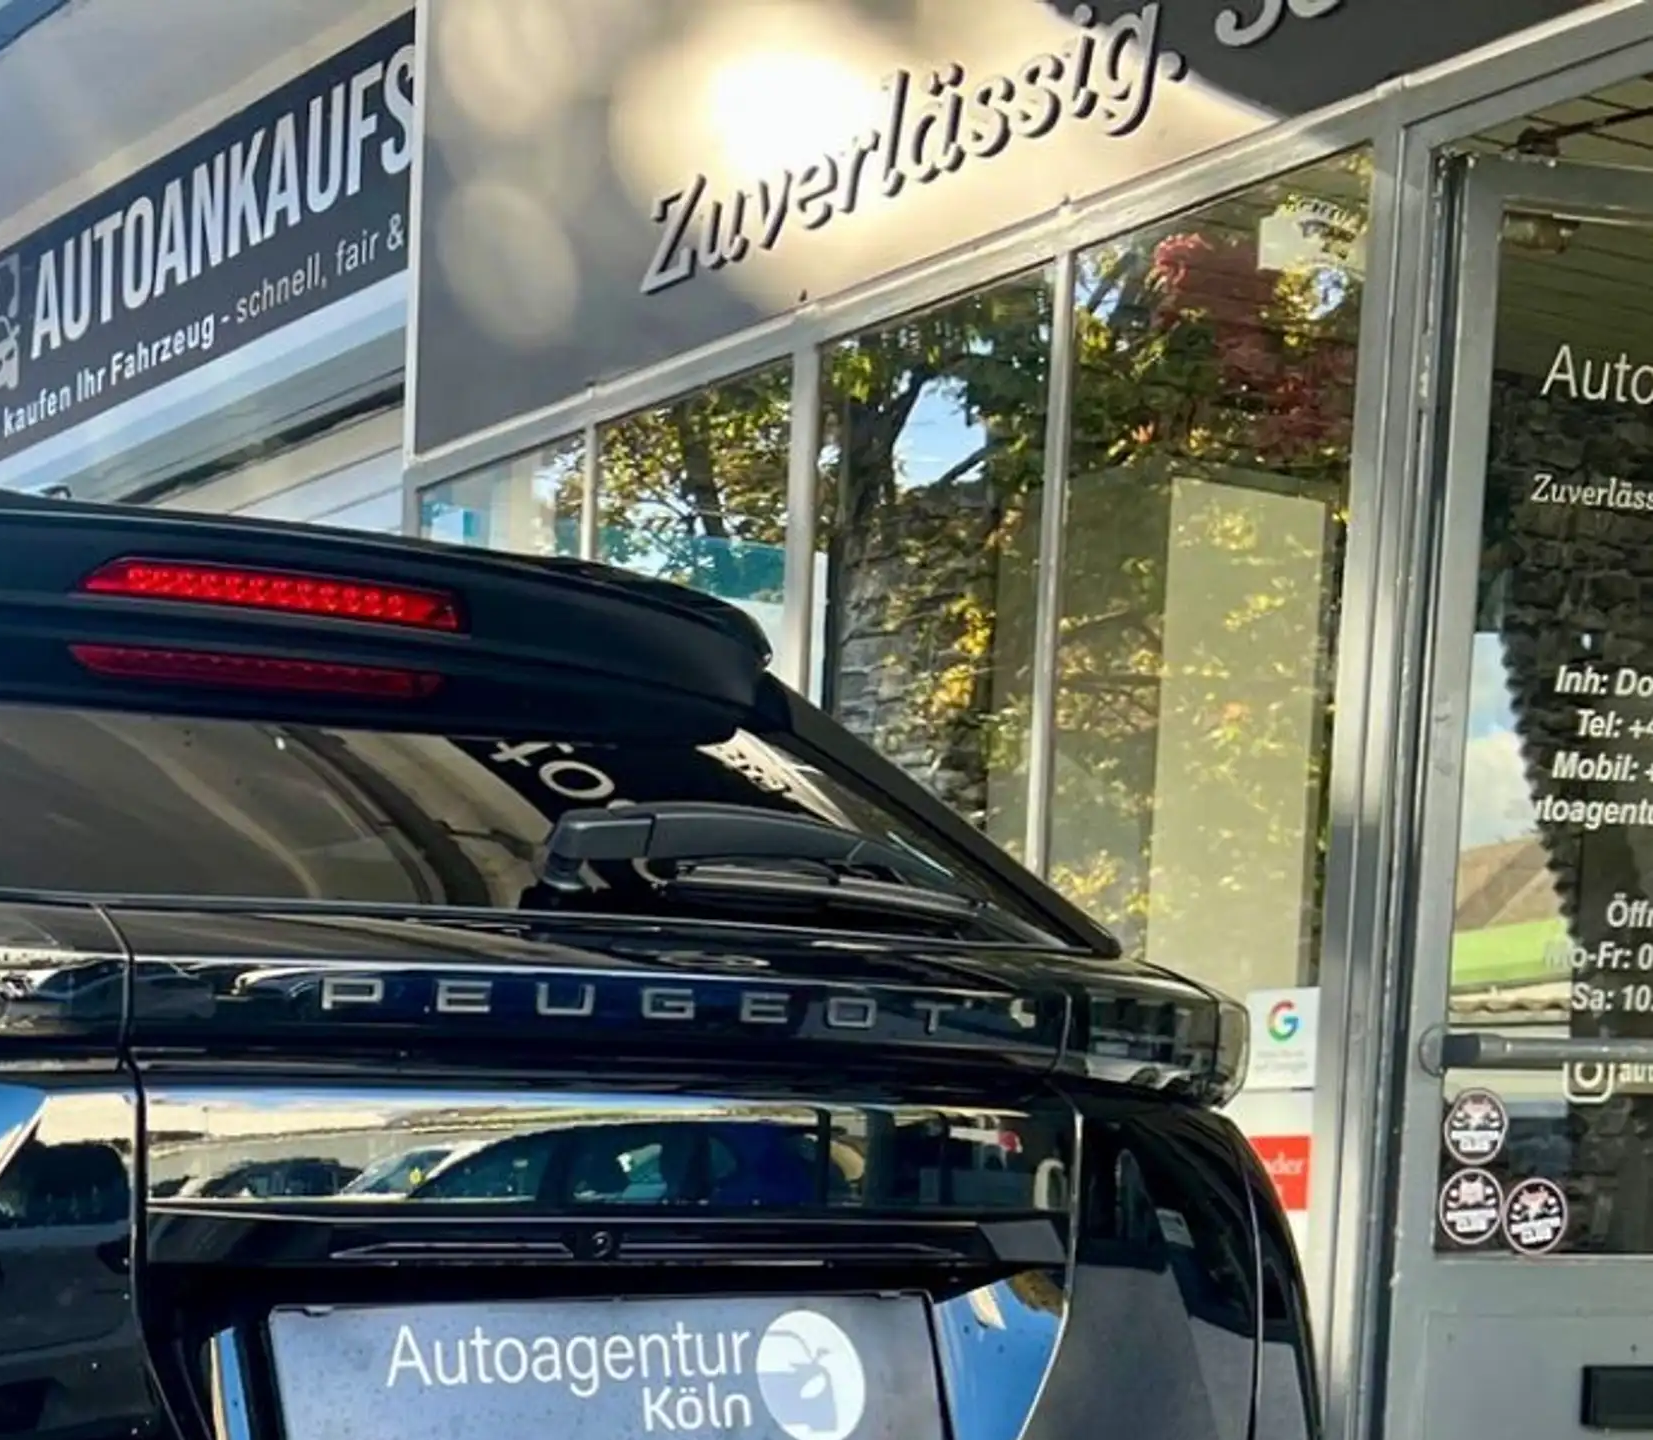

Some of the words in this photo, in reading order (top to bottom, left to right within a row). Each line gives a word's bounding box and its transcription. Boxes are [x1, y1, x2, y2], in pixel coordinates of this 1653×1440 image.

[640, 3, 1188, 294] Zuverlässig.
[3, 380, 71, 438] kaufen
[76, 365, 106, 400] Ihr
[110, 315, 215, 386] Fahrzeug
[235, 250, 328, 324] schnell,
[336, 234, 377, 275] fair
[386, 212, 404, 251] &
[1554, 664, 1609, 695] Inh:
[1576, 708, 1624, 738] Tel:
[1552, 751, 1639, 781] Mobil:
[321, 975, 946, 1034] PEUGEOT
[1570, 982, 1615, 1012] Sa:
[385, 1322, 751, 1398] Autoagentur
[643, 1386, 753, 1432] Köln
